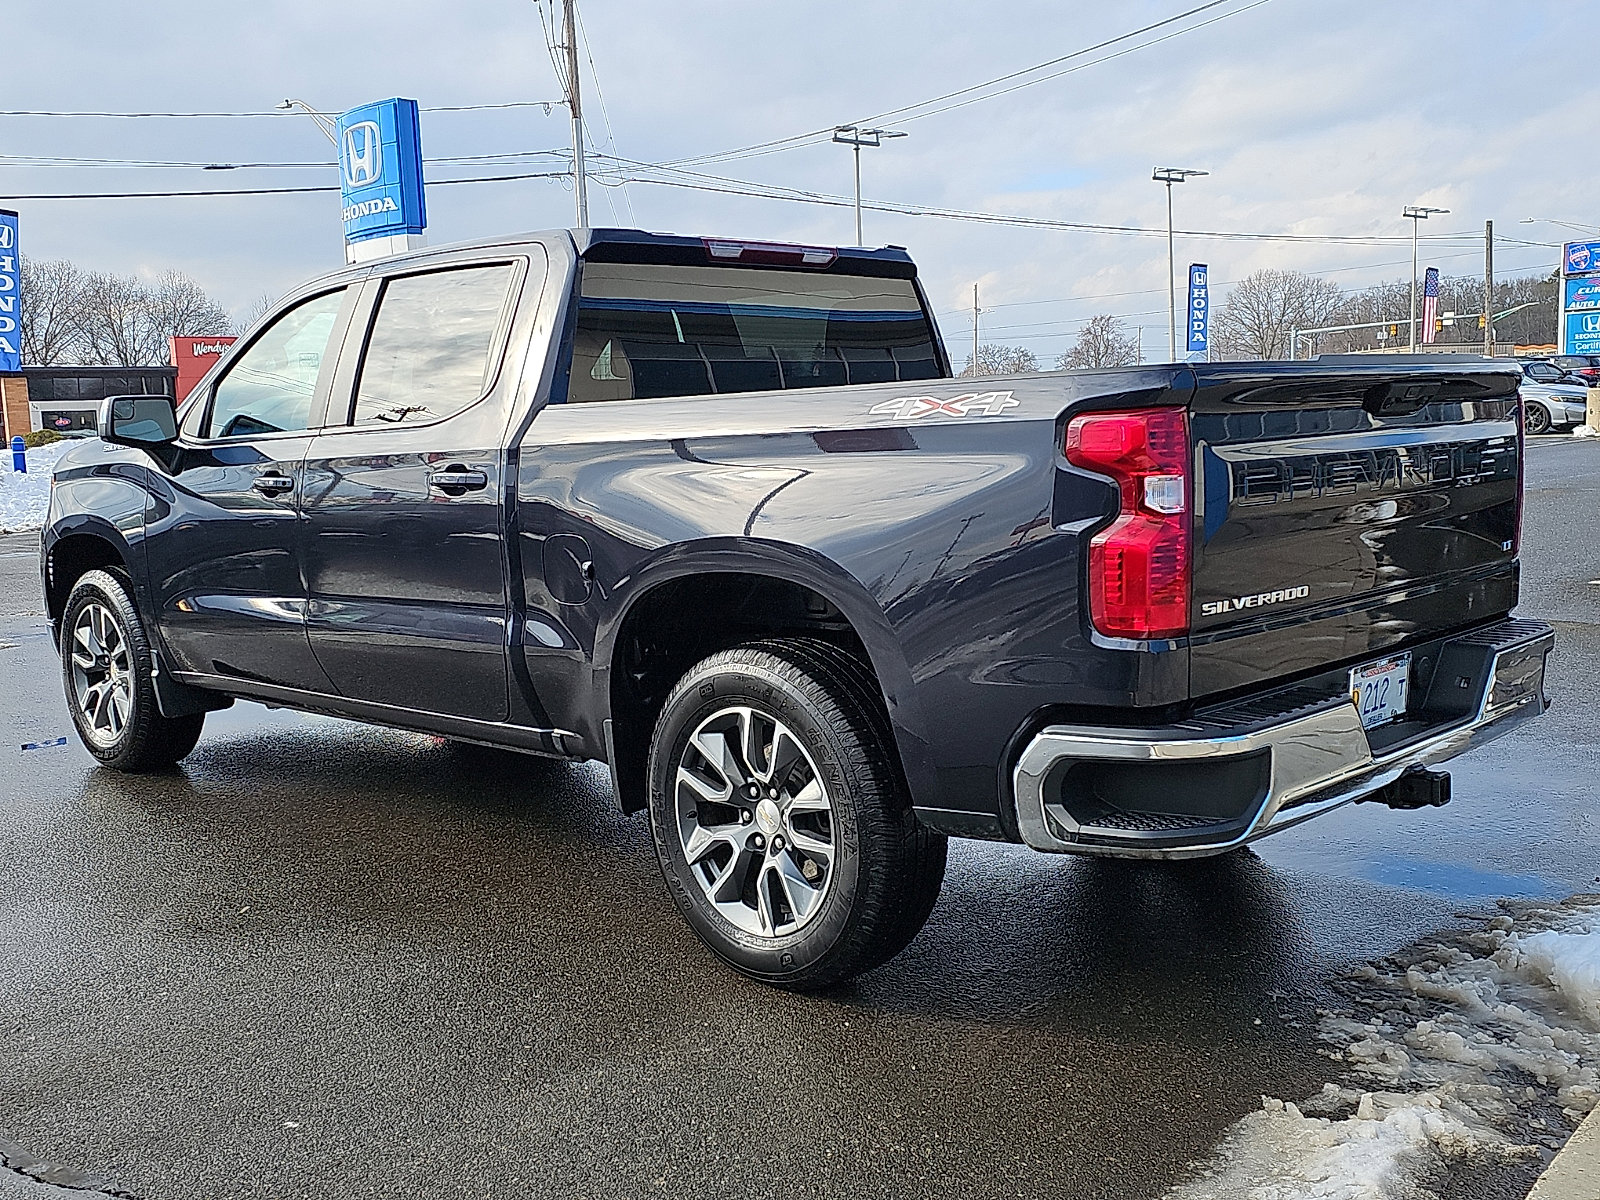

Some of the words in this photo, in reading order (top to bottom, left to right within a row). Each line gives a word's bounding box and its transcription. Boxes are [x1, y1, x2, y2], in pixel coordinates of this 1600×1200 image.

[341, 197, 399, 222] HONDA
[1191, 288, 1207, 342] HONDA
[192, 341, 231, 357] Wendy's
[1236, 445, 1516, 508] CHEVROLET
[1201, 585, 1309, 616] SILVERADO
[1363, 676, 1390, 716] 212
[1398, 679, 1406, 697] T
